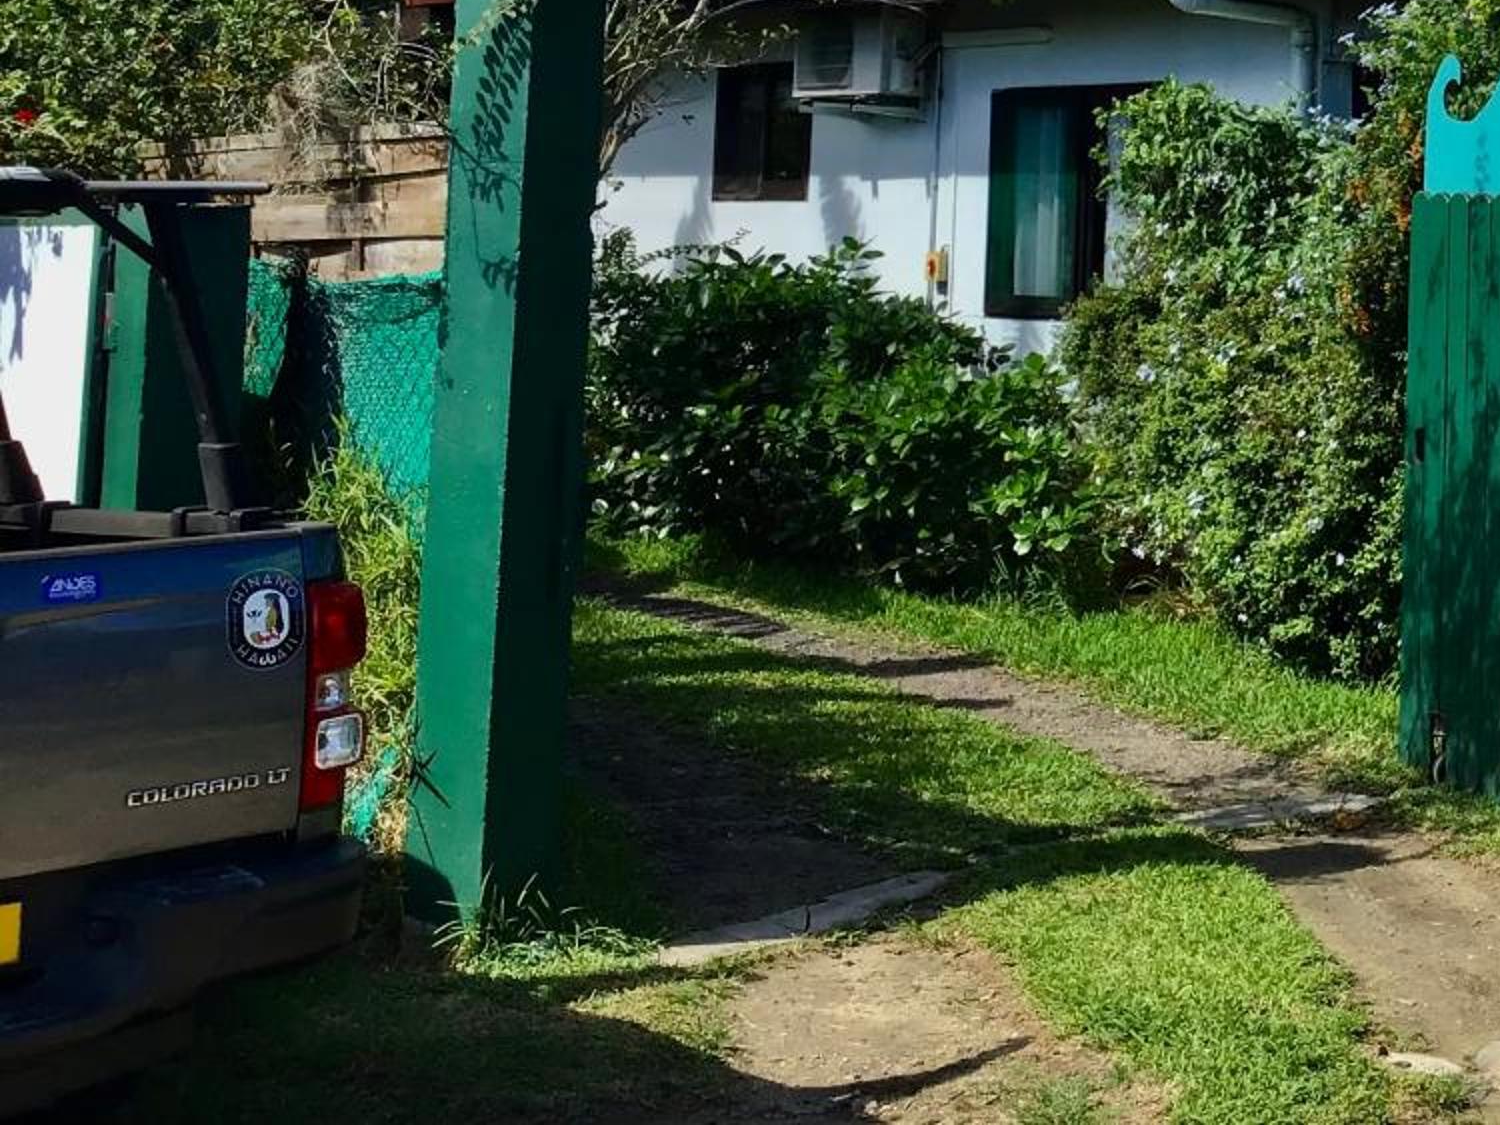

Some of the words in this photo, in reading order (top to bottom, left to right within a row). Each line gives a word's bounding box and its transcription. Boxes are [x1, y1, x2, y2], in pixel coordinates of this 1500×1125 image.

[232, 574, 298, 604] HINANO
[127, 775, 260, 807] COLORADO
[267, 767, 292, 785] LT
